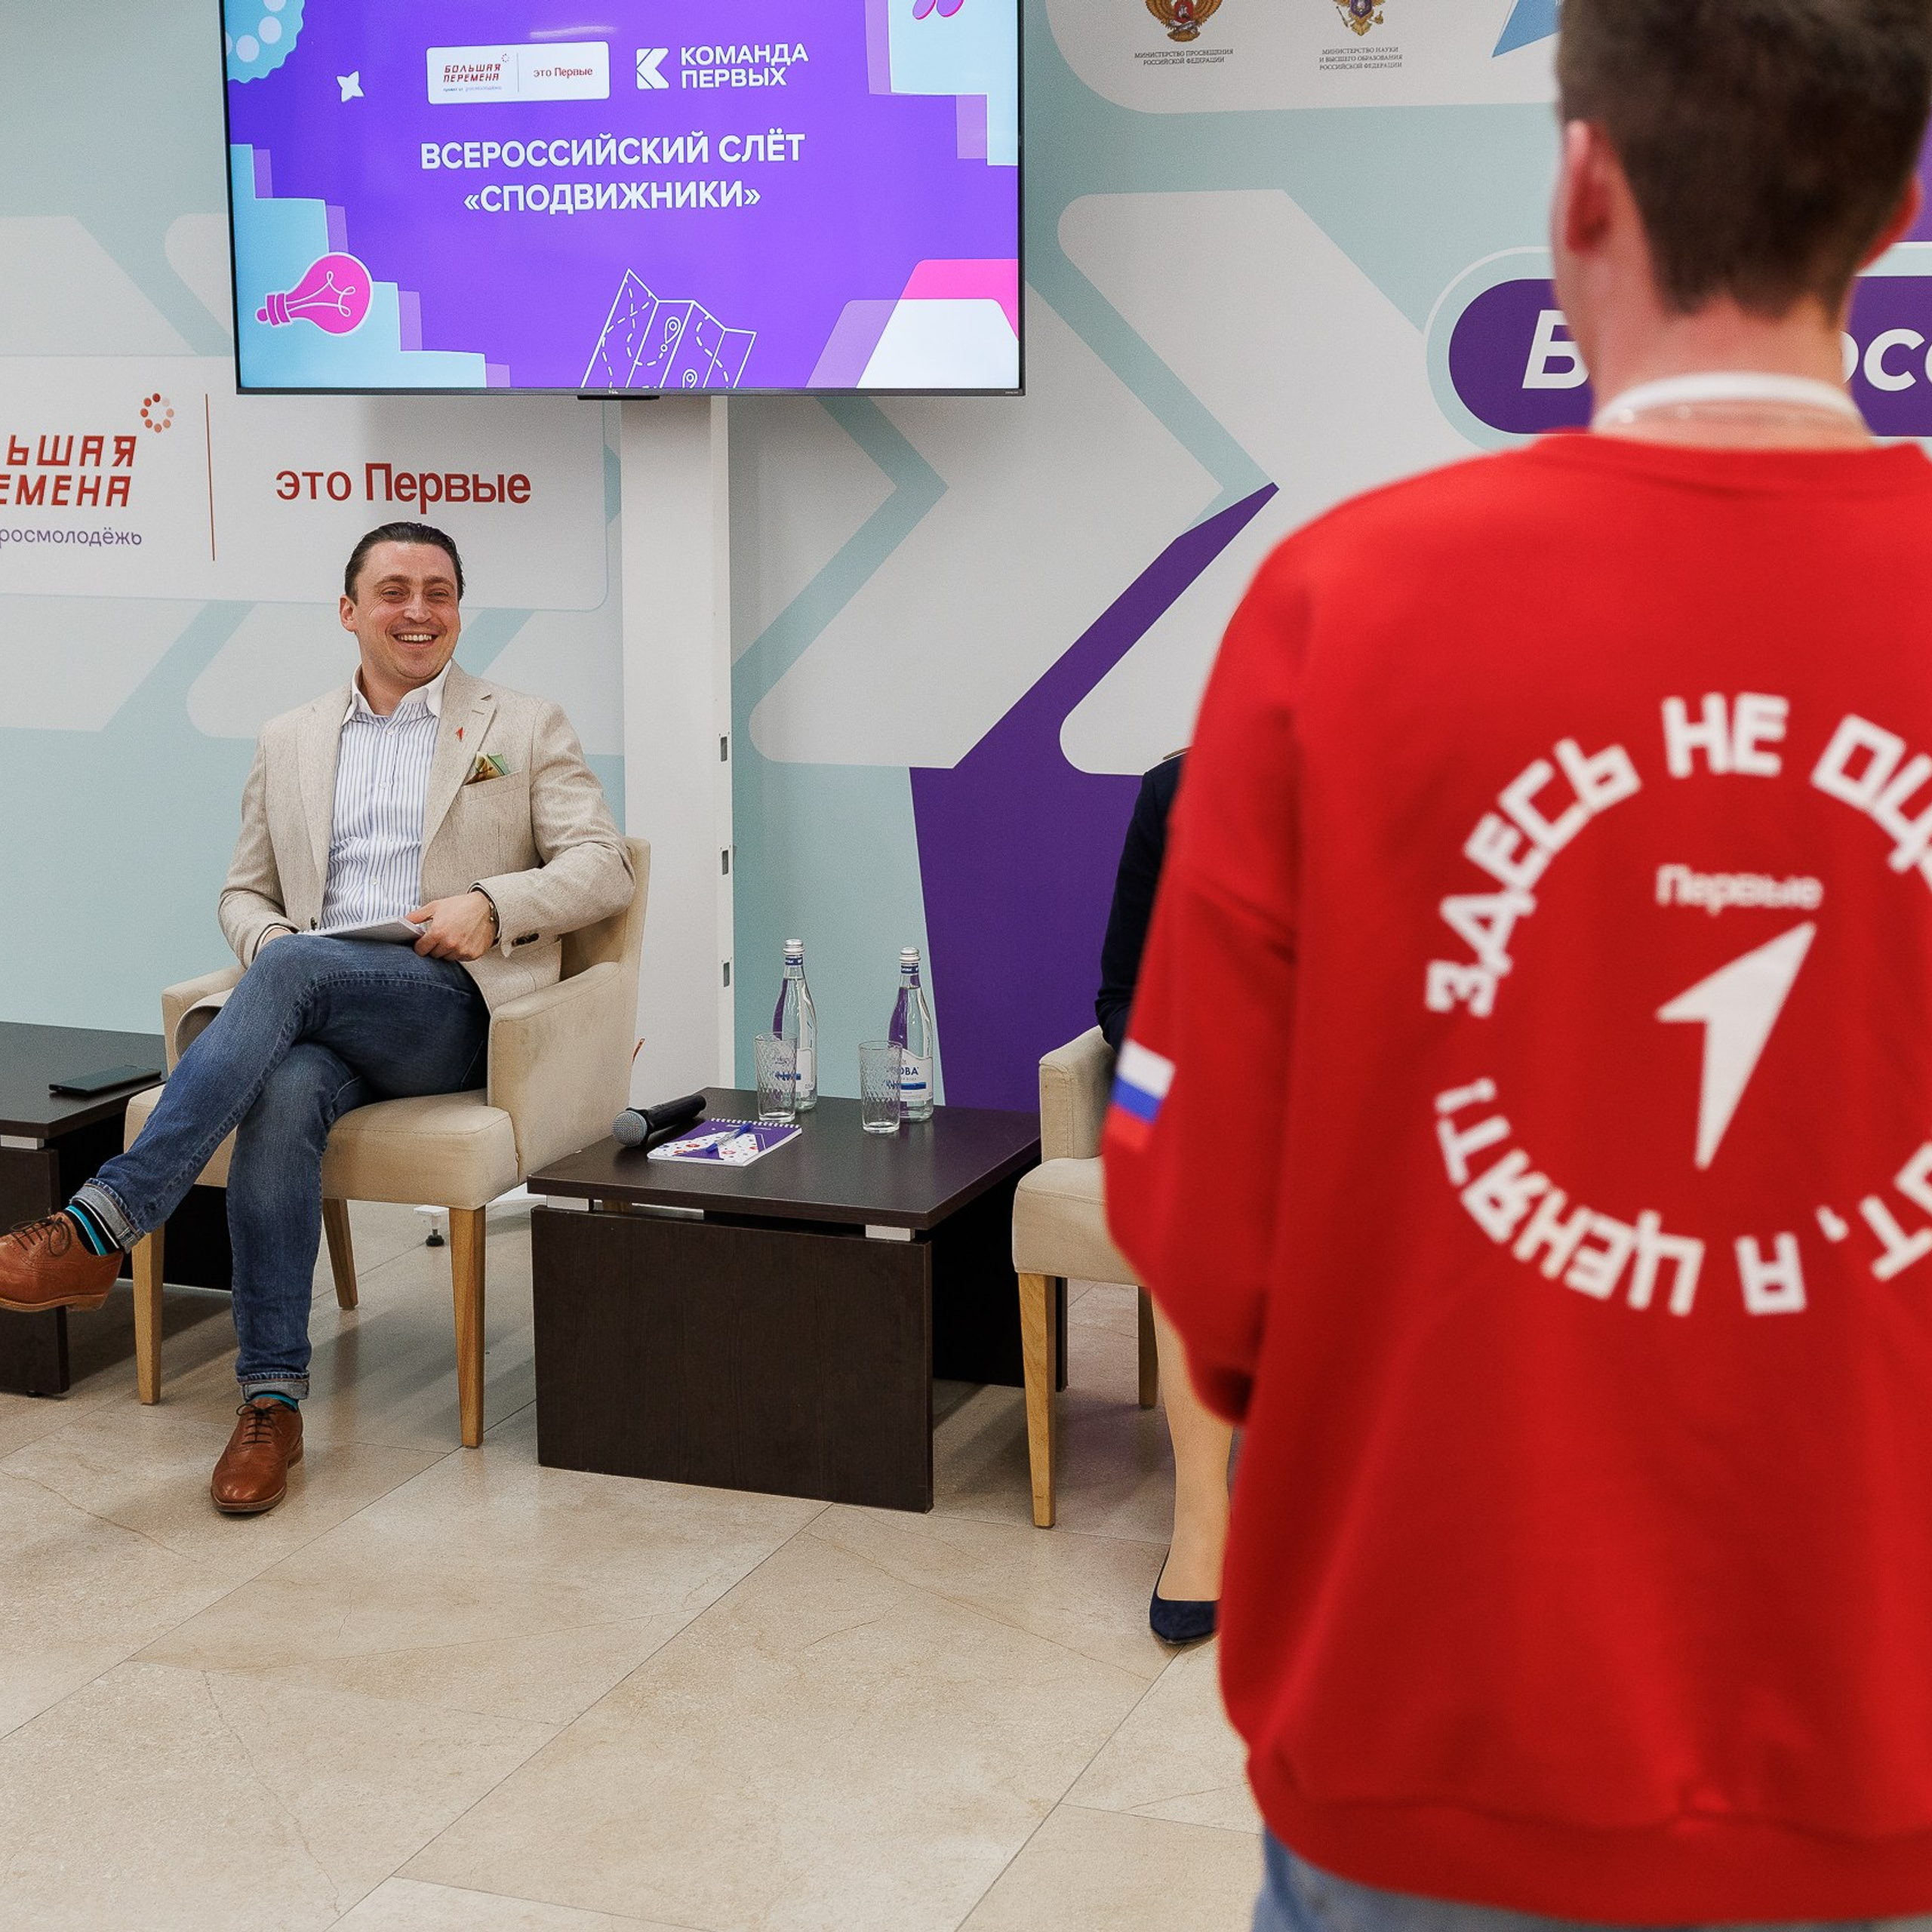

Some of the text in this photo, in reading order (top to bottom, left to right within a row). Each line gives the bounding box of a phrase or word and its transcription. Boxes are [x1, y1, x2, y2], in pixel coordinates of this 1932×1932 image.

[681, 43, 809, 66] КОМАНДА
[1134, 48, 1234, 58] МИНИСТЕРСТВО ПРОСВЕЩЕНИЯ
[1143, 56, 1225, 66] РОССИЙСКОЙ ФЕДЕРАЦИИ
[1321, 47, 1374, 55] МИНИСТЕРСТВО
[443, 73, 500, 83] ПЕРЕМЕНА
[444, 63, 501, 73] БОЛЬШАЯ
[533, 66, 594, 79] это Первые
[681, 66, 787, 89] ПЕРВЫХ
[421, 128, 805, 169] ВСЕРОССИЙСКИЙ СЛЁТ
[463, 180, 761, 215] «СПОДВИЖНИКИ»
[276, 463, 531, 514] это Первые
[1661, 691, 1790, 780] НЕ
[1425, 737, 1641, 1019] ЗДЕСЬ
[1656, 863, 1824, 915] Первые
[1435, 1077, 1706, 1316] ЦЕНЯТ!
